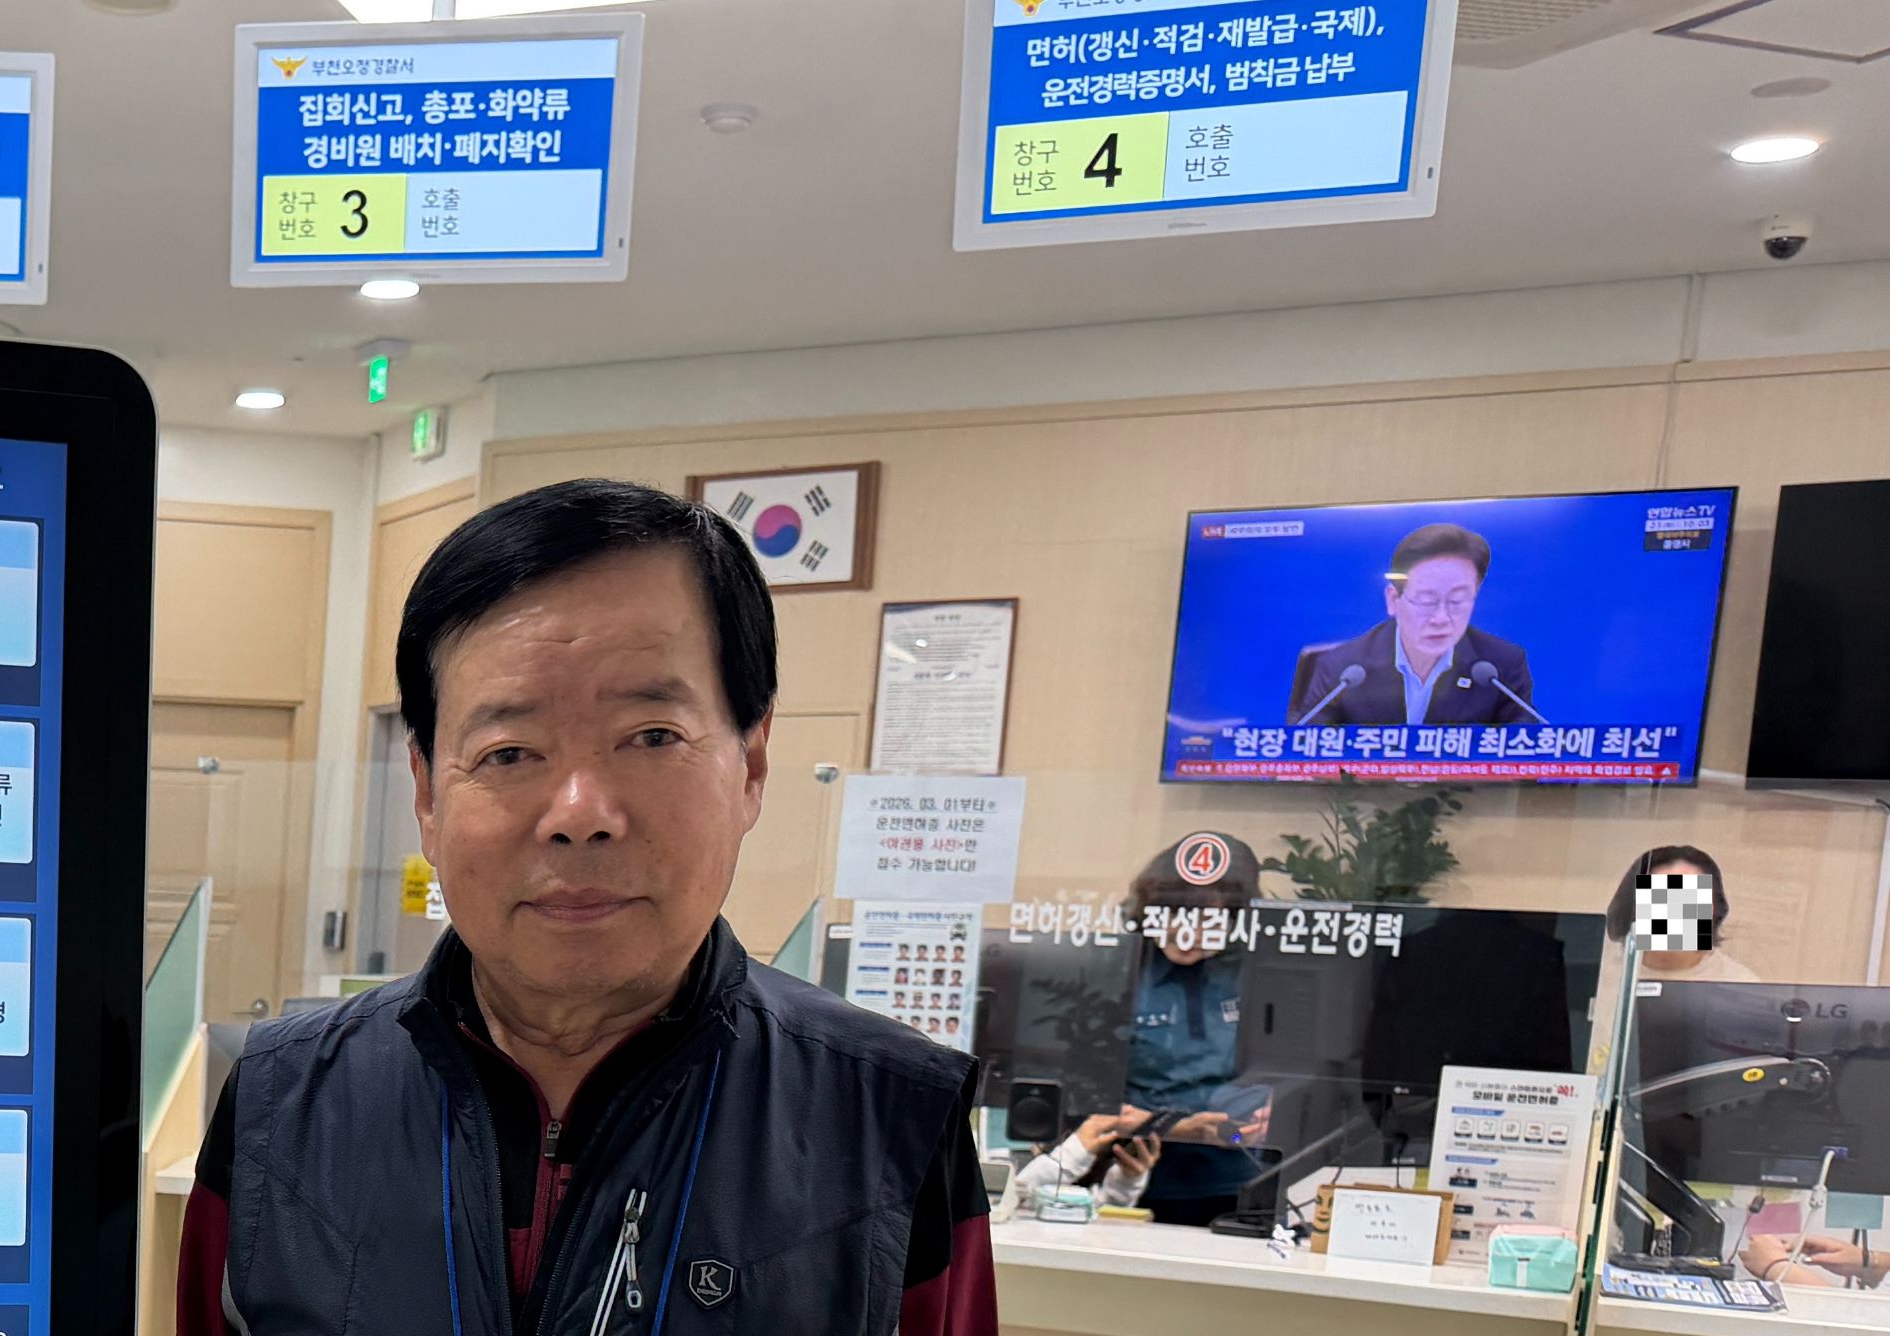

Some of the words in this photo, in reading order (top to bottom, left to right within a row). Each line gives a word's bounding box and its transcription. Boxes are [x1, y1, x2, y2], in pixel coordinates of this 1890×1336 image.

[312, 58, 414, 76] 부천오정경찰서
[1041, 65, 1215, 108] 운전경력증명서,
[1225, 57, 1299, 90] 범칙금
[1304, 53, 1355, 85] 납부
[299, 94, 413, 127] 집회신고,
[421, 89, 571, 124] 총포·화약류
[304, 134, 382, 168] 경비원
[389, 130, 561, 165] 배치·폐지확인
[1083, 133, 1122, 188] 4
[340, 189, 368, 238] 3
[1815, 1004, 1847, 1018] LG
[699, 1266, 721, 1290] K
